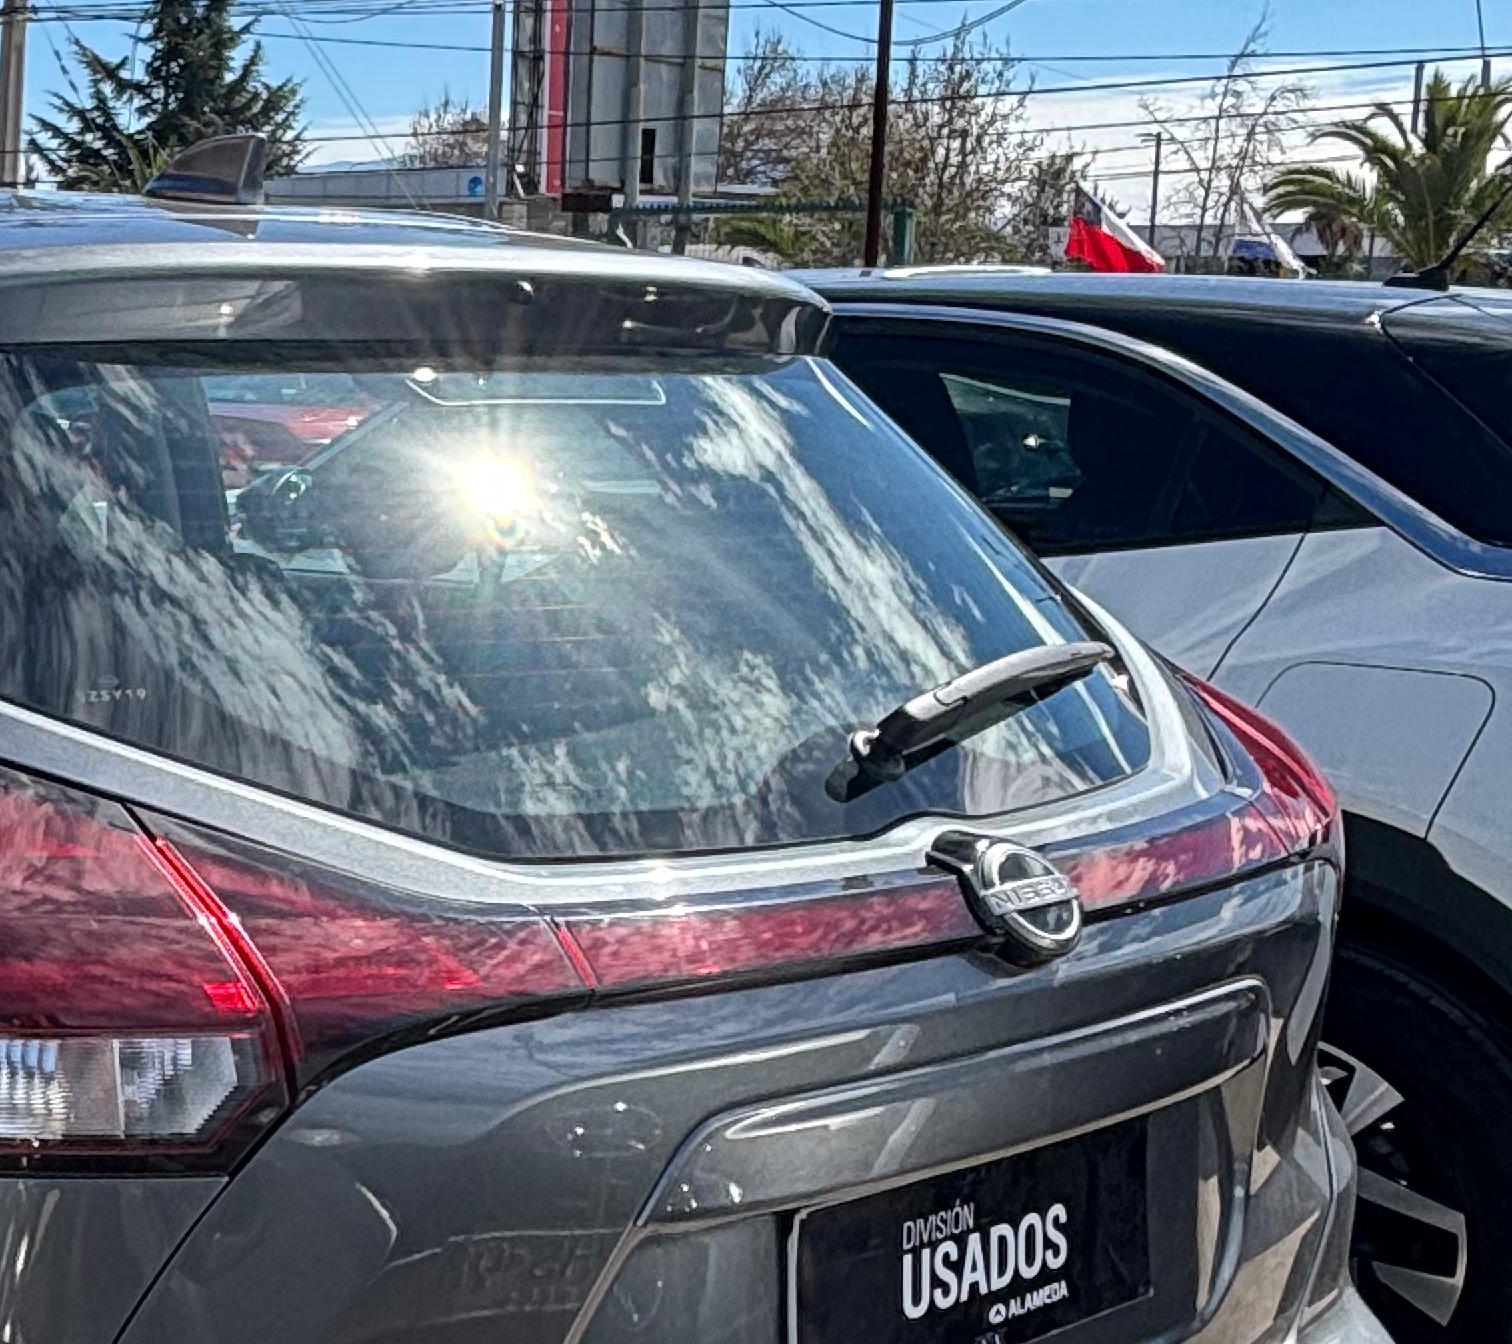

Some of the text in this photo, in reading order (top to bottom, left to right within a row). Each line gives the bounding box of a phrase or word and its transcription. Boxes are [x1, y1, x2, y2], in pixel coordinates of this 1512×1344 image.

[903, 1198, 975, 1250] DIVISIÓN
[902, 1203, 1068, 1319] USADOS
[1008, 1279, 1070, 1319] ALAMEDA
